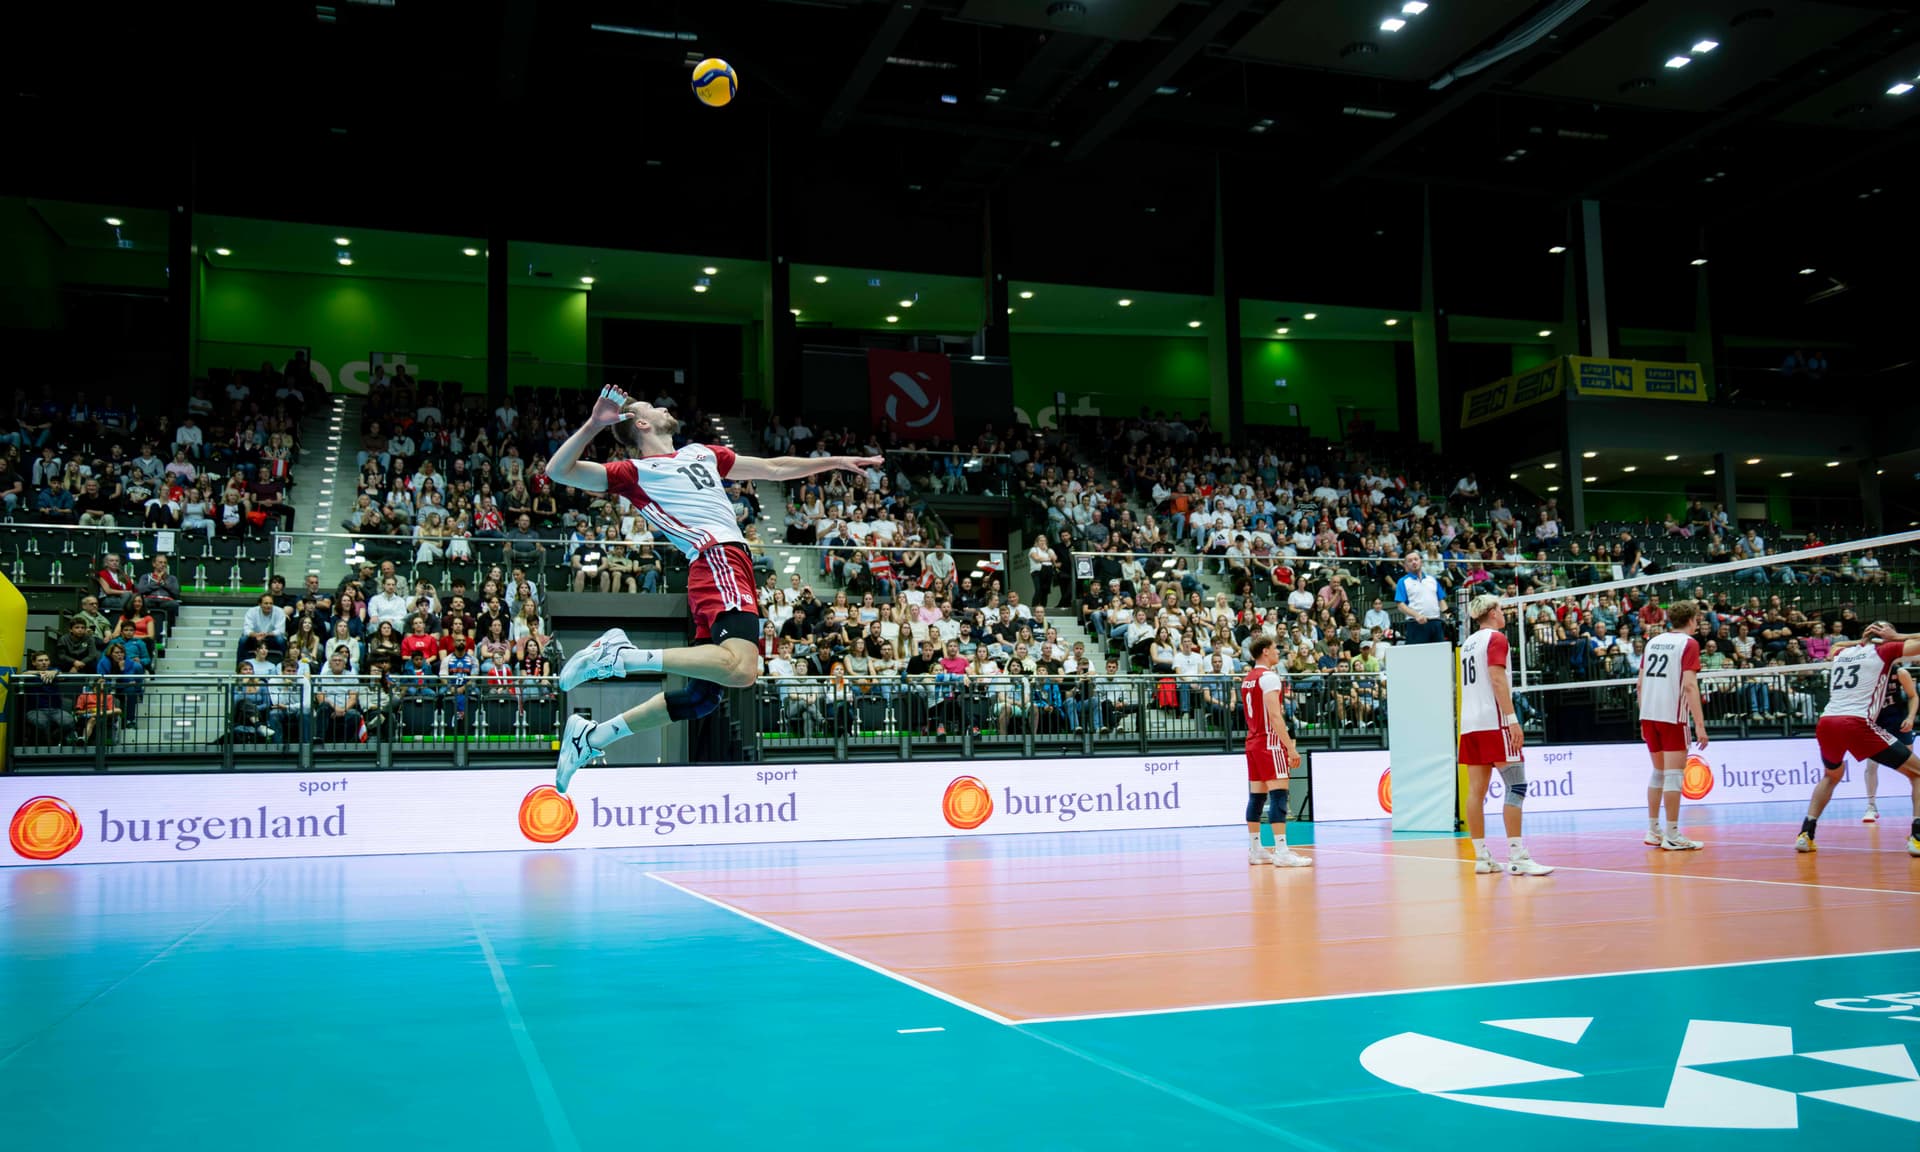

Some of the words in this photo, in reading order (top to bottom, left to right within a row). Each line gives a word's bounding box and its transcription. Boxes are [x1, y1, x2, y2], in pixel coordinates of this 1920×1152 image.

[677, 463, 716, 490] 19
[1462, 655, 1476, 686] 16
[1646, 653, 1669, 678] 22
[1832, 664, 1862, 690] 23
[1144, 760, 1180, 775] sport
[1543, 750, 1573, 764] sport
[299, 778, 348, 796] sport
[756, 768, 798, 784] sport
[1721, 760, 1851, 793] burgenlad
[591, 792, 798, 835] burgenland
[1004, 782, 1181, 822] burgenland
[99, 804, 348, 851] burgenland
